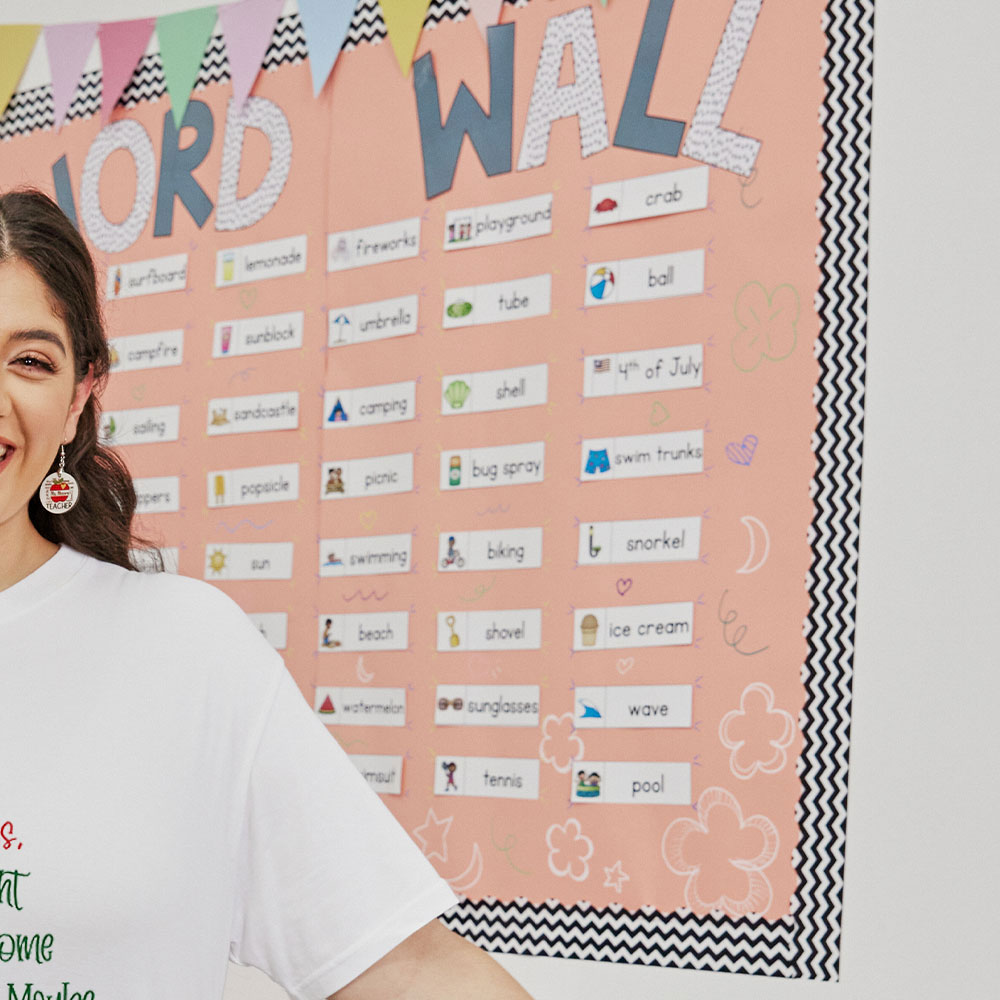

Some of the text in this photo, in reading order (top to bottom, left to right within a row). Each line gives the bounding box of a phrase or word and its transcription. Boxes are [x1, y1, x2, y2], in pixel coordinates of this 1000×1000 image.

[413, 0, 762, 201] WALL
[645, 182, 683, 207] crab
[475, 200, 552, 236] playground
[355, 234, 417, 257] fireworks
[244, 248, 302, 272] lemonade
[128, 268, 187, 289] surfboard
[648, 265, 674, 288] ball
[499, 290, 530, 312] tube
[359, 308, 412, 333] umbrella
[245, 325, 296, 346] sunblock
[127, 341, 179, 362] campfire
[645, 358, 663, 379] of
[669, 355, 702, 378] July
[496, 378, 526, 401] shell
[234, 402, 297, 421] sandcastle
[358, 396, 408, 419] camping
[614, 442, 703, 465] swim trunks
[364, 469, 398, 488] picnic
[472, 458, 542, 481] bug spray
[240, 478, 290, 498] popsicle
[487, 541, 525, 563] biking
[626, 529, 686, 553] snorkel
[250, 556, 271, 571] sun
[349, 549, 408, 568] swimming
[358, 623, 395, 642] beach
[485, 620, 526, 640] shovel
[609, 619, 690, 638] ice cream
[342, 701, 405, 715] watermelon
[467, 695, 539, 718] sunglasses
[628, 702, 669, 717] wave
[483, 769, 523, 788] tennis
[631, 774, 665, 798] pool
